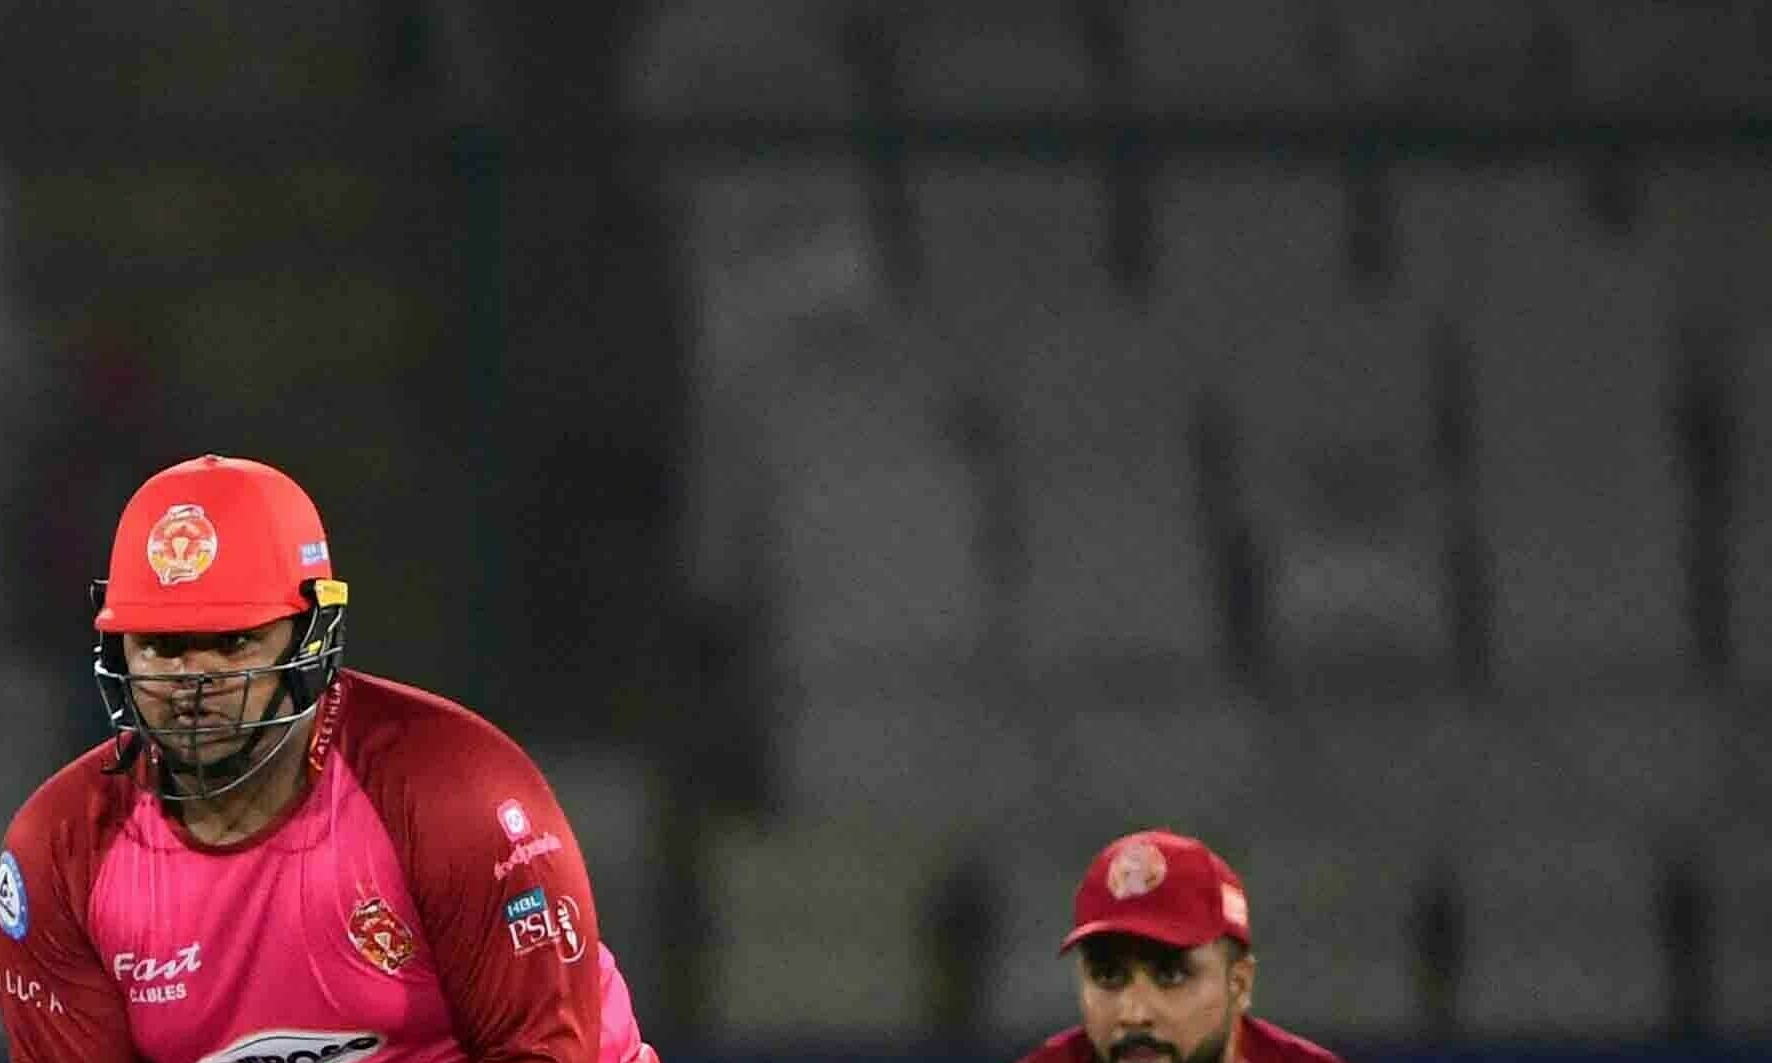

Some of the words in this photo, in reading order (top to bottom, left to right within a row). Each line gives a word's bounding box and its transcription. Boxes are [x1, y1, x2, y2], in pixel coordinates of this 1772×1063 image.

[507, 896, 541, 917] HBL
[508, 908, 561, 950] PSL
[113, 941, 202, 981] Fast
